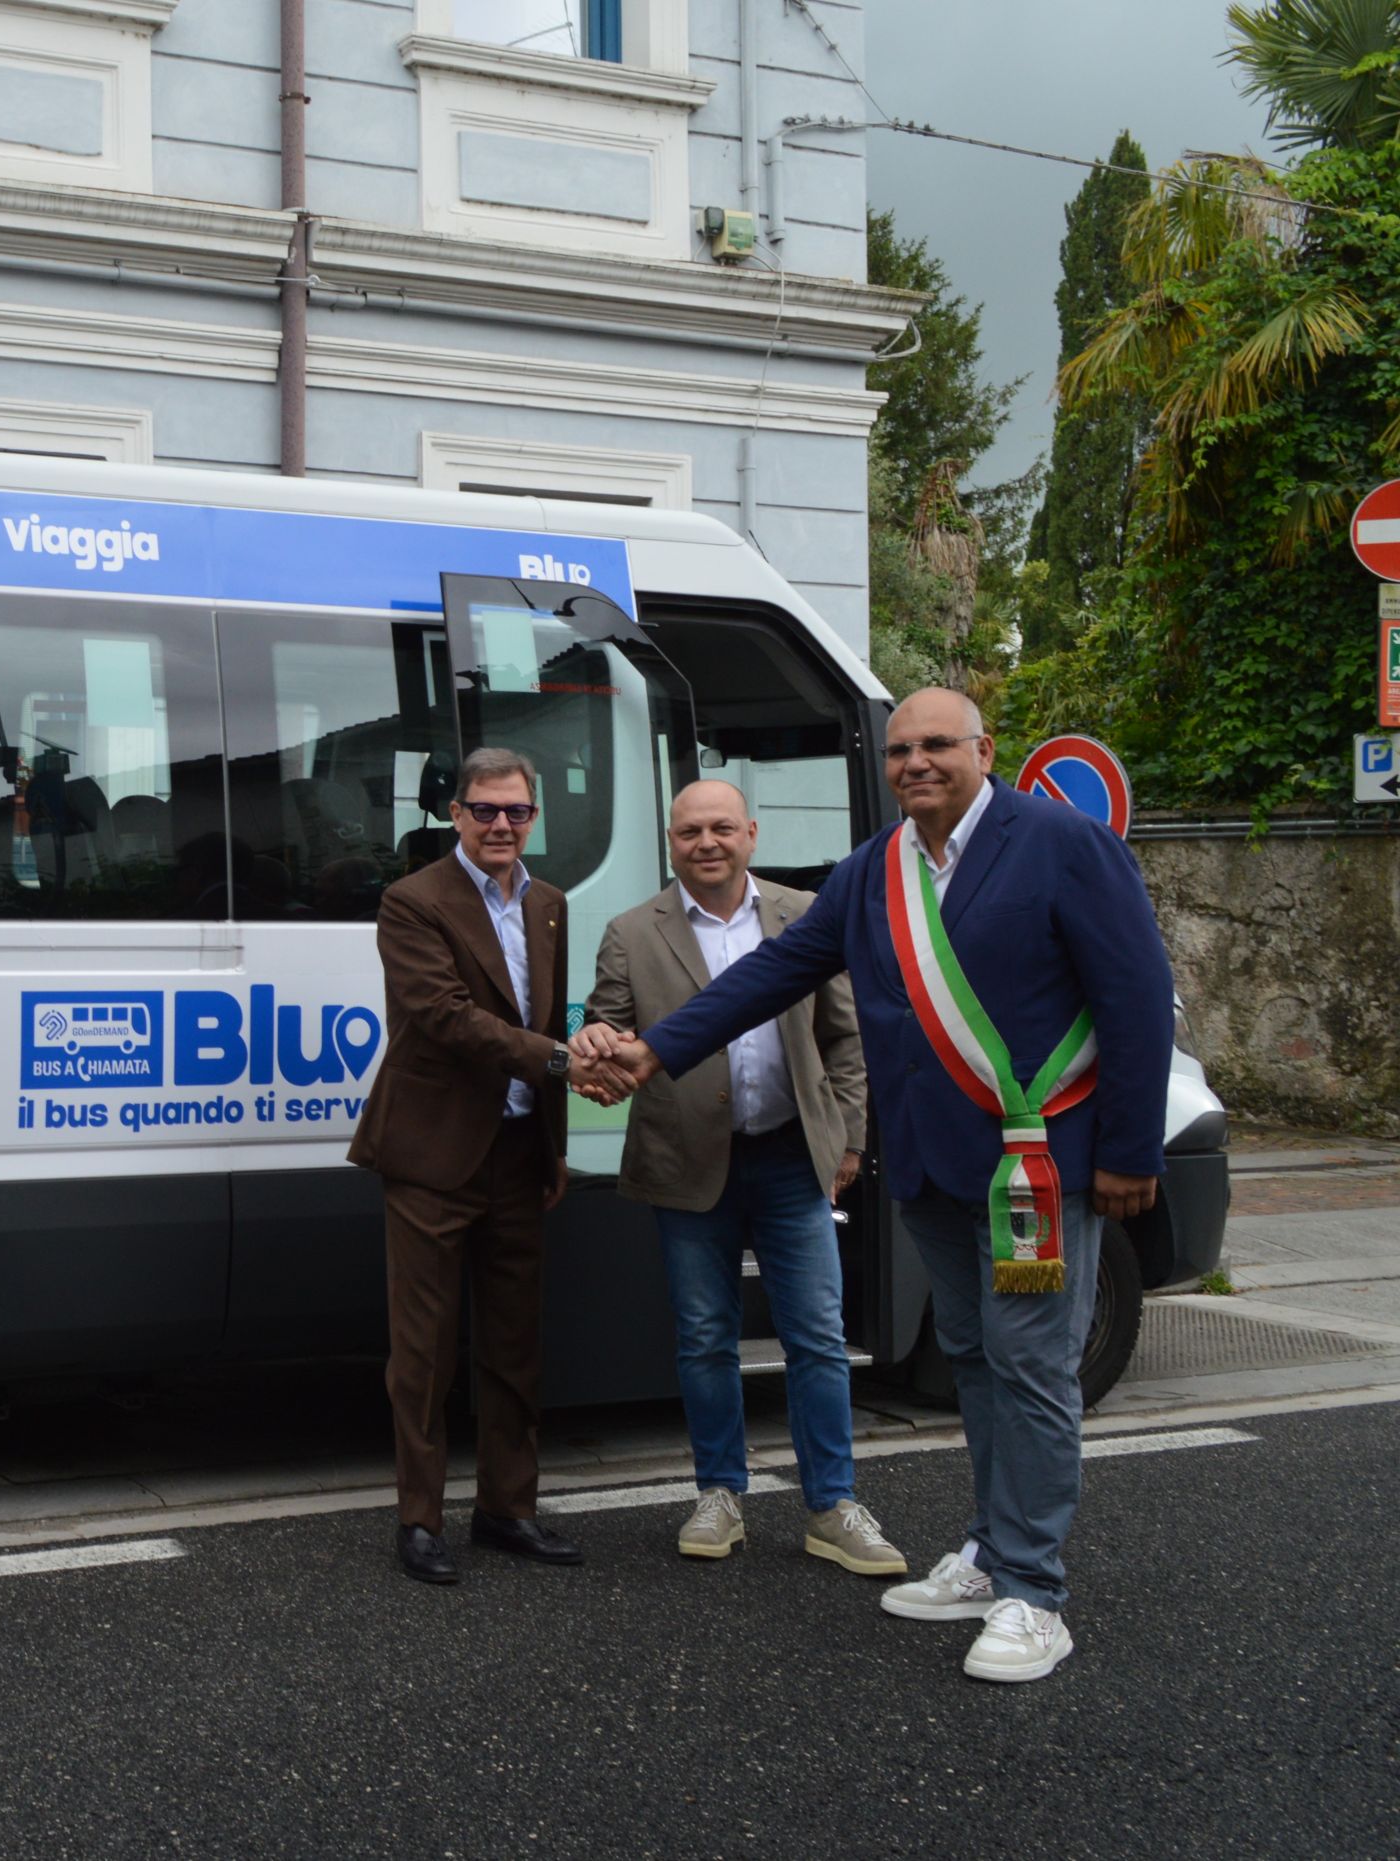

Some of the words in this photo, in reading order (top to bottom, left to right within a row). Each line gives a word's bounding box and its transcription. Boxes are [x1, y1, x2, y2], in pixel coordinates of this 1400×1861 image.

[2, 513, 160, 572] Viaggia
[33, 1059, 62, 1077] BUS
[64, 1059, 75, 1076] A
[18, 1095, 35, 1129] il
[45, 1099, 109, 1129] bus
[119, 1095, 245, 1133] quando
[255, 1090, 276, 1122] ti
